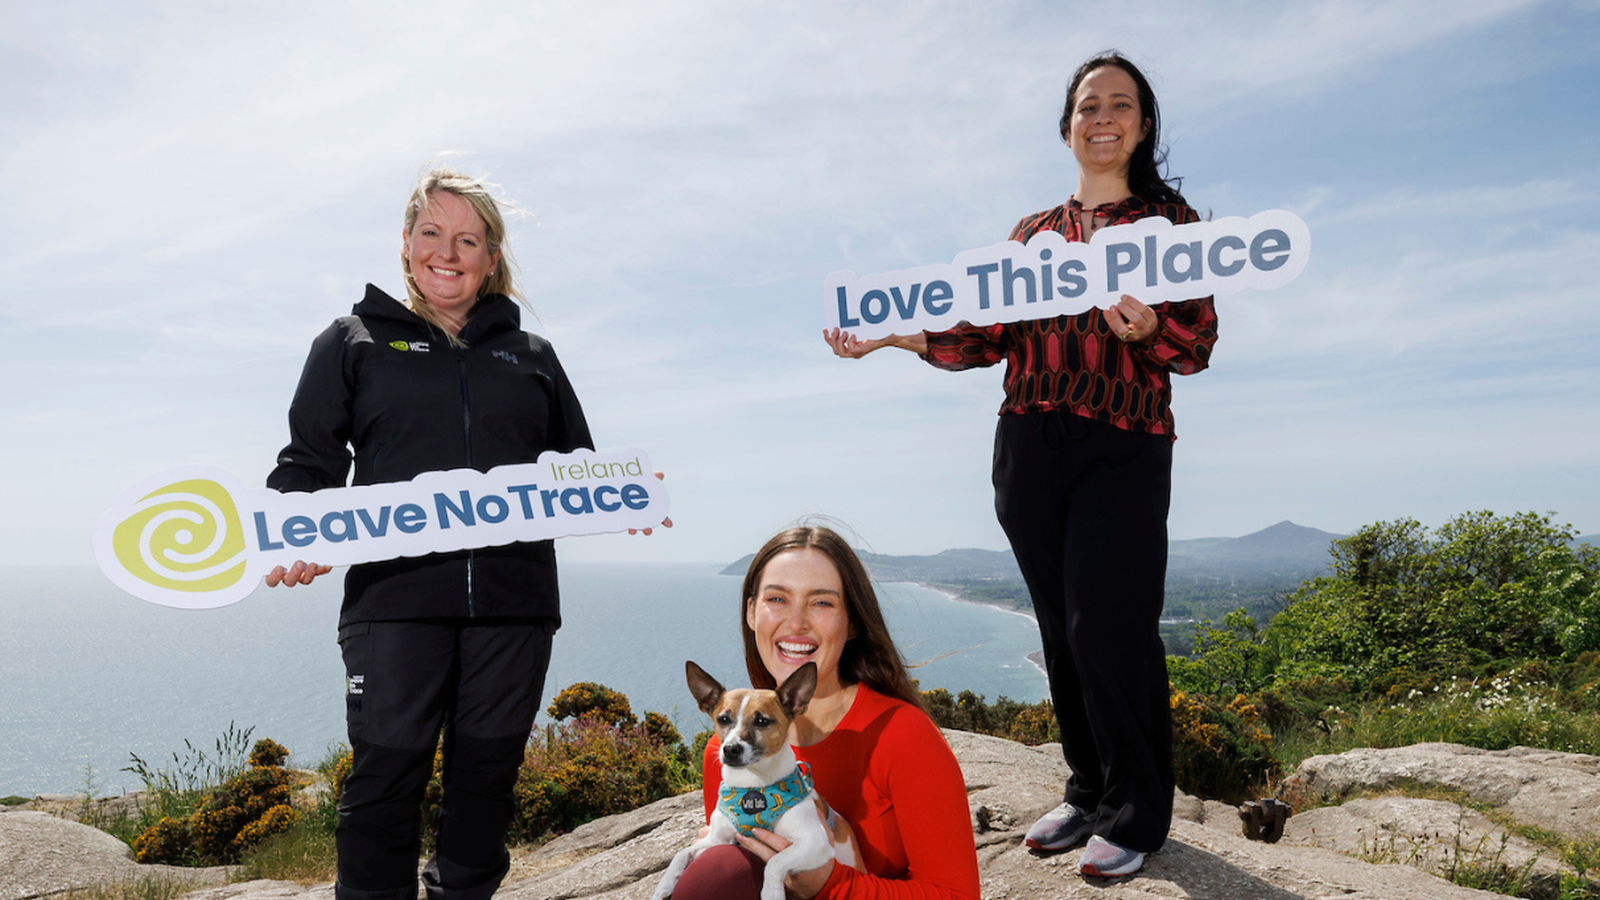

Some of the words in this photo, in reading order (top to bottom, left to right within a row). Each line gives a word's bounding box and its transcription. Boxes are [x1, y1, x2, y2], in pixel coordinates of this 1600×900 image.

[836, 279, 954, 329] Love
[967, 248, 1088, 310] This
[1105, 228, 1292, 293] Place
[550, 457, 644, 482] Ireland
[253, 503, 428, 552] Leave
[433, 490, 510, 530] No
[506, 483, 650, 520] Trace
